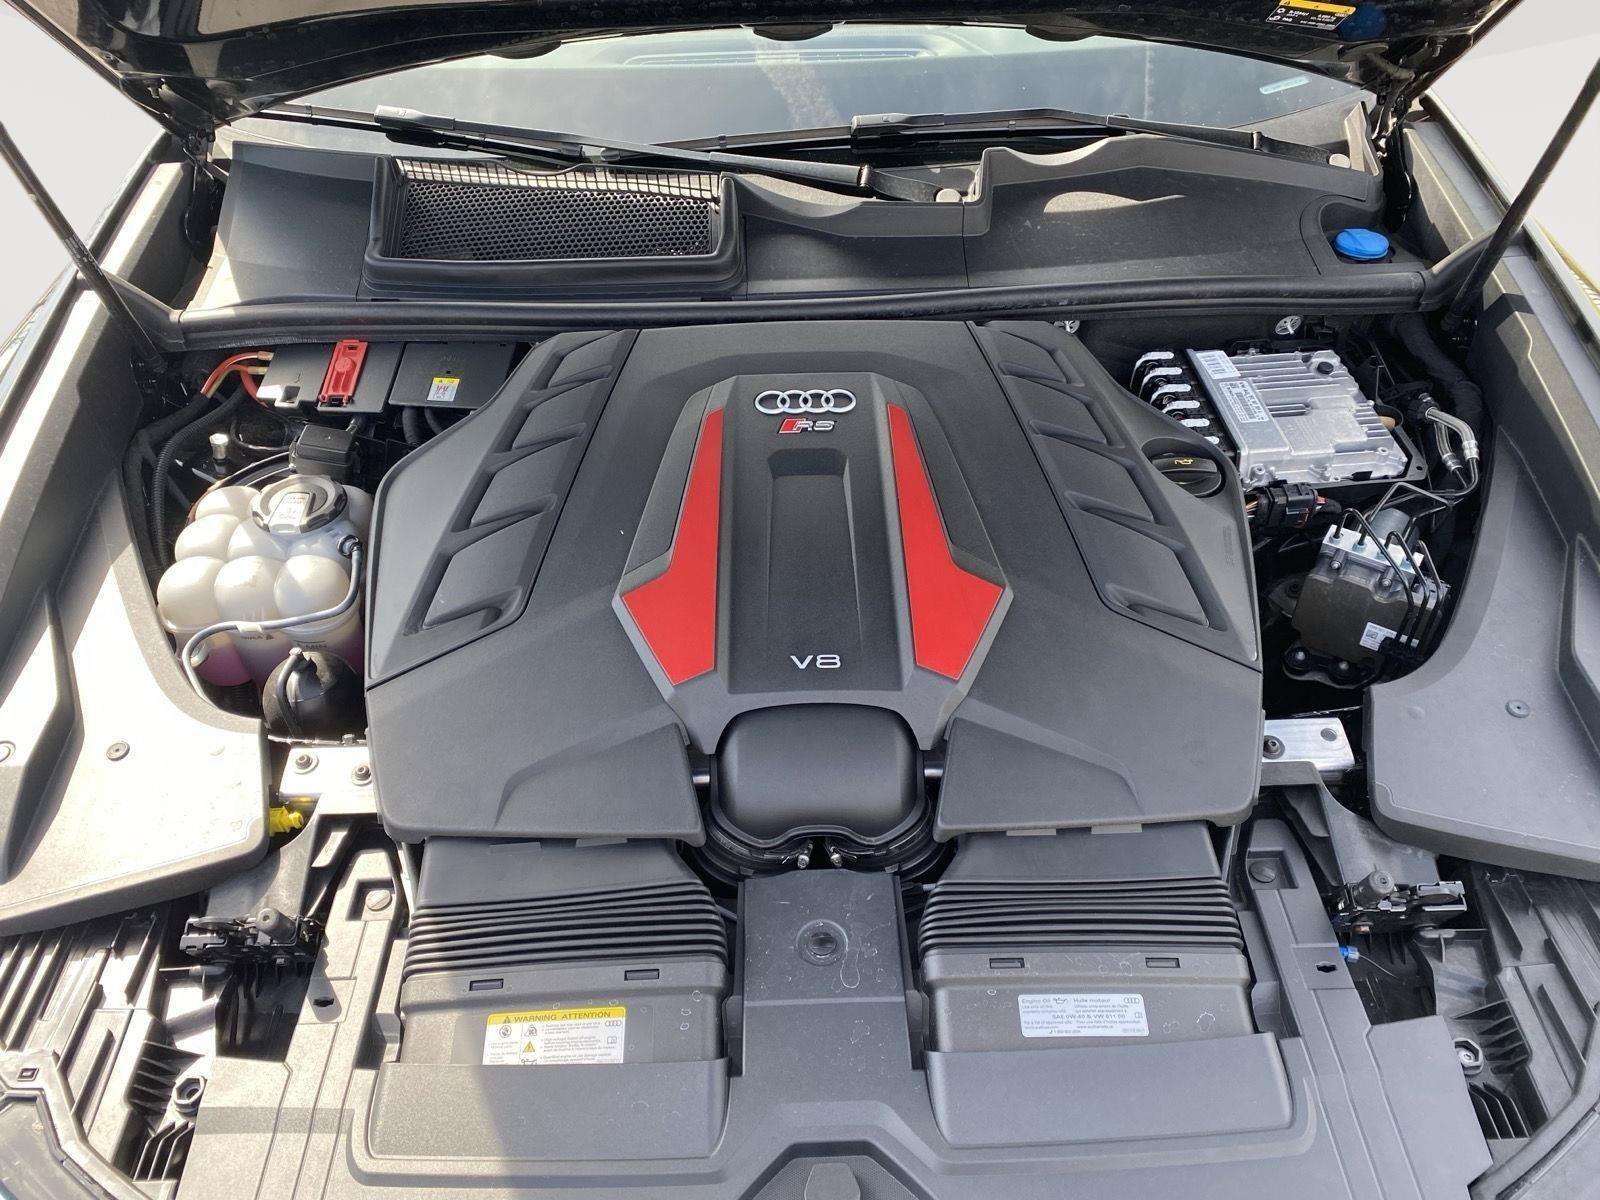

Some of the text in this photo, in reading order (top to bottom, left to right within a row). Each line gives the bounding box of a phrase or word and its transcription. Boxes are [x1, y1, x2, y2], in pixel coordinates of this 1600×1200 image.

[781, 418, 835, 432] RS
[790, 654, 841, 669] V8
[514, 1011, 611, 1023] WARNING ATTENTION
